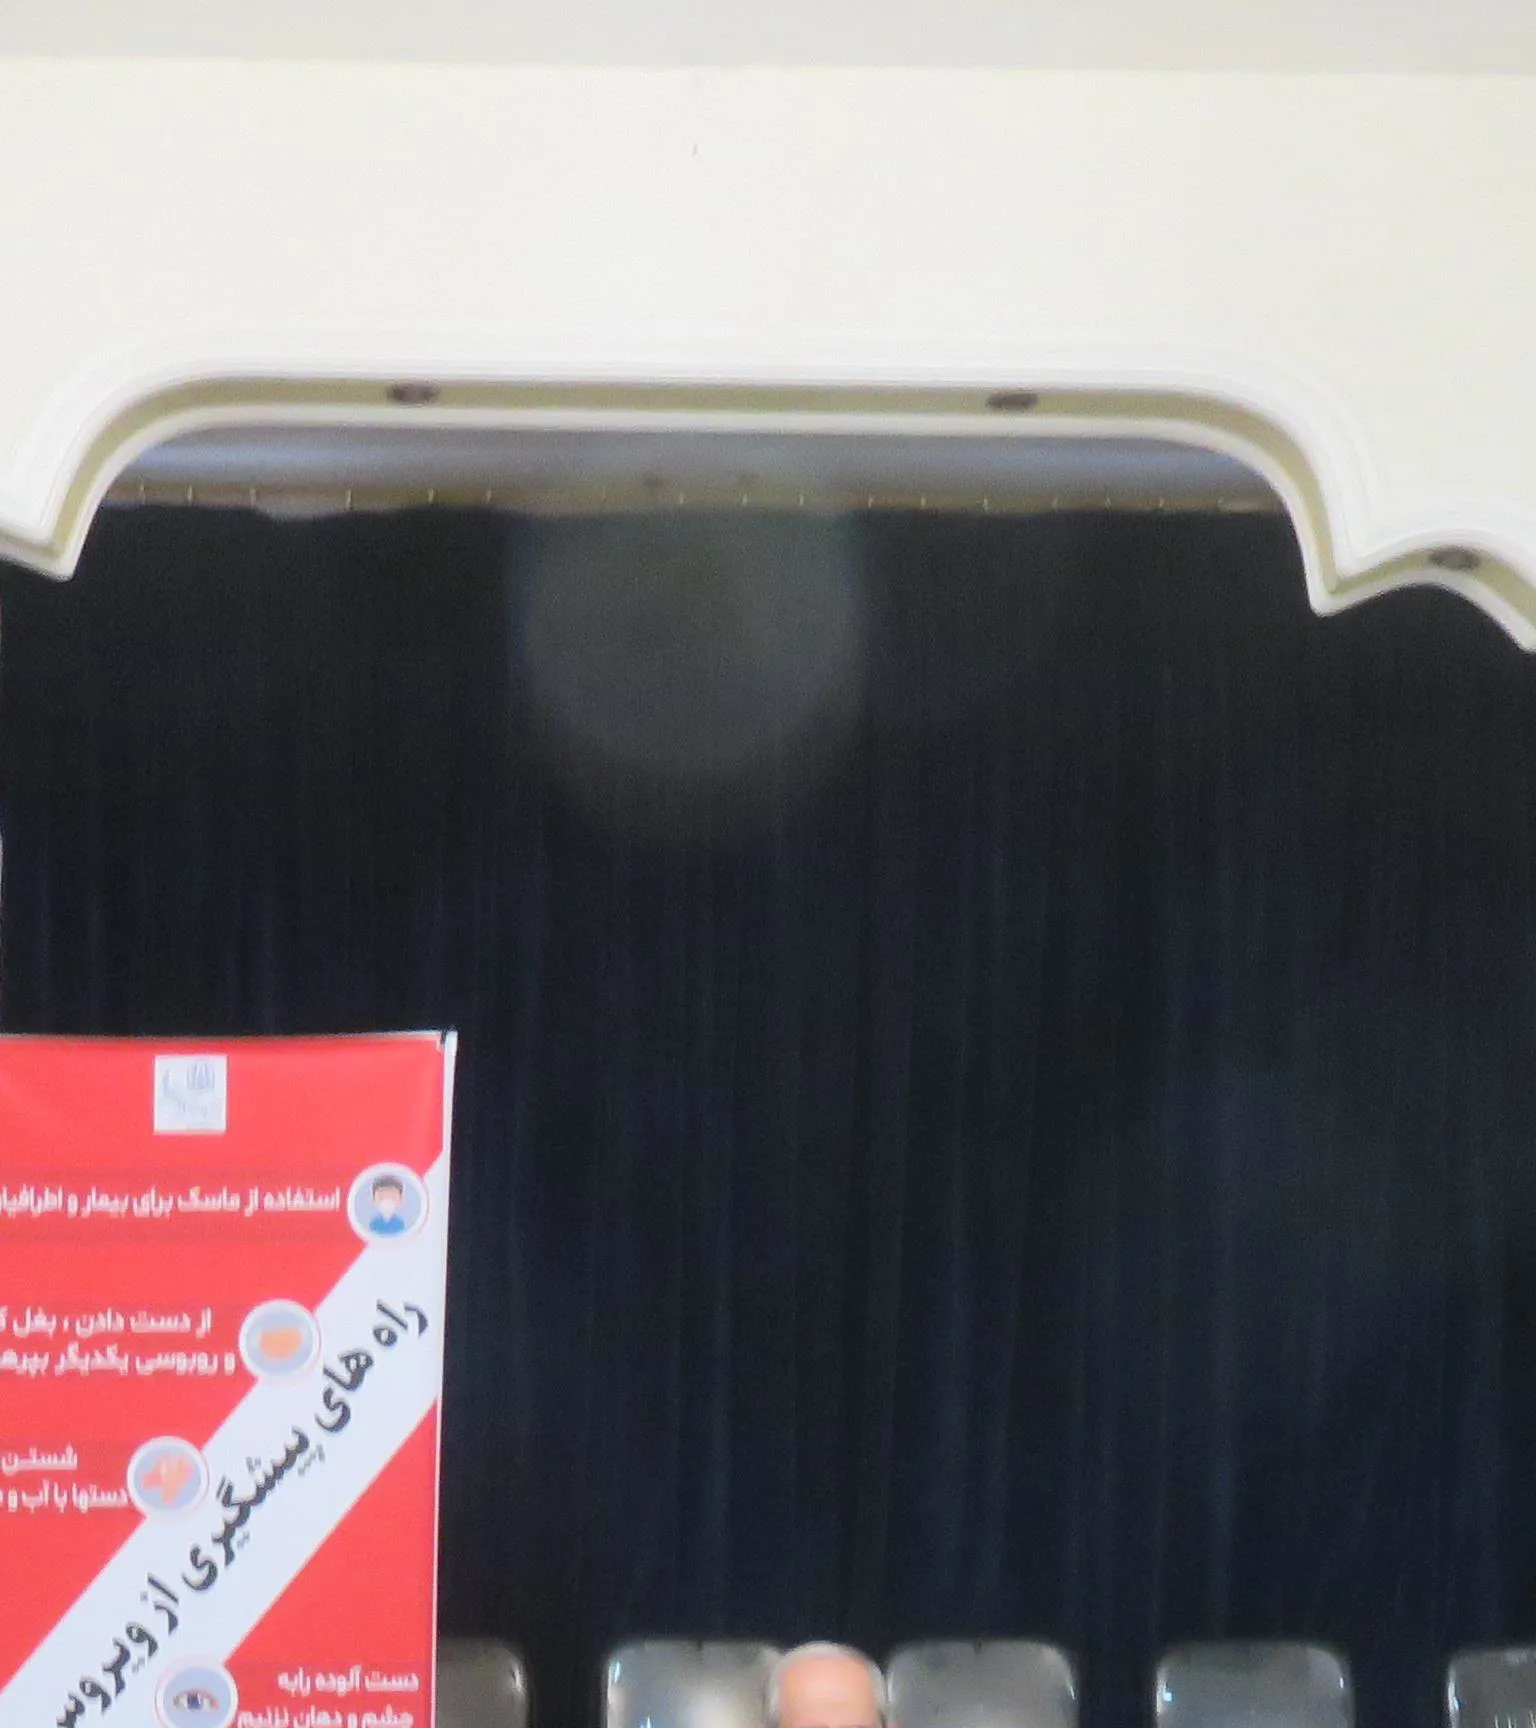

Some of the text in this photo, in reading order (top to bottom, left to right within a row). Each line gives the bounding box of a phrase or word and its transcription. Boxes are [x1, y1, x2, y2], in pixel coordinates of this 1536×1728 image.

[68, 1194, 78, 1216] و
[81, 1188, 129, 1217] بیمار
[133, 1188, 173, 1217] برای
[177, 1186, 240, 1211] ماسک
[245, 1187, 259, 1216] از
[264, 1187, 340, 1211] استفاده
[13, 1307, 56, 1338] بغل
[75, 1308, 124, 1338] دادن
[130, 1312, 191, 1333] دست
[196, 1308, 211, 1338] از
[373, 1301, 428, 1347] راه
[55, 1342, 129, 1375] یکدیگر
[224, 1353, 235, 1374] و
[314, 1350, 374, 1432] های
[8, 1489, 18, 1512] و
[22, 1480, 49, 1513] آب
[53, 1483, 67, 1512] با
[182, 1426, 325, 1591] پیشگیری
[140, 1573, 179, 1635] از
[315, 1665, 361, 1696] آلوده
[365, 1672, 419, 1691] دست
